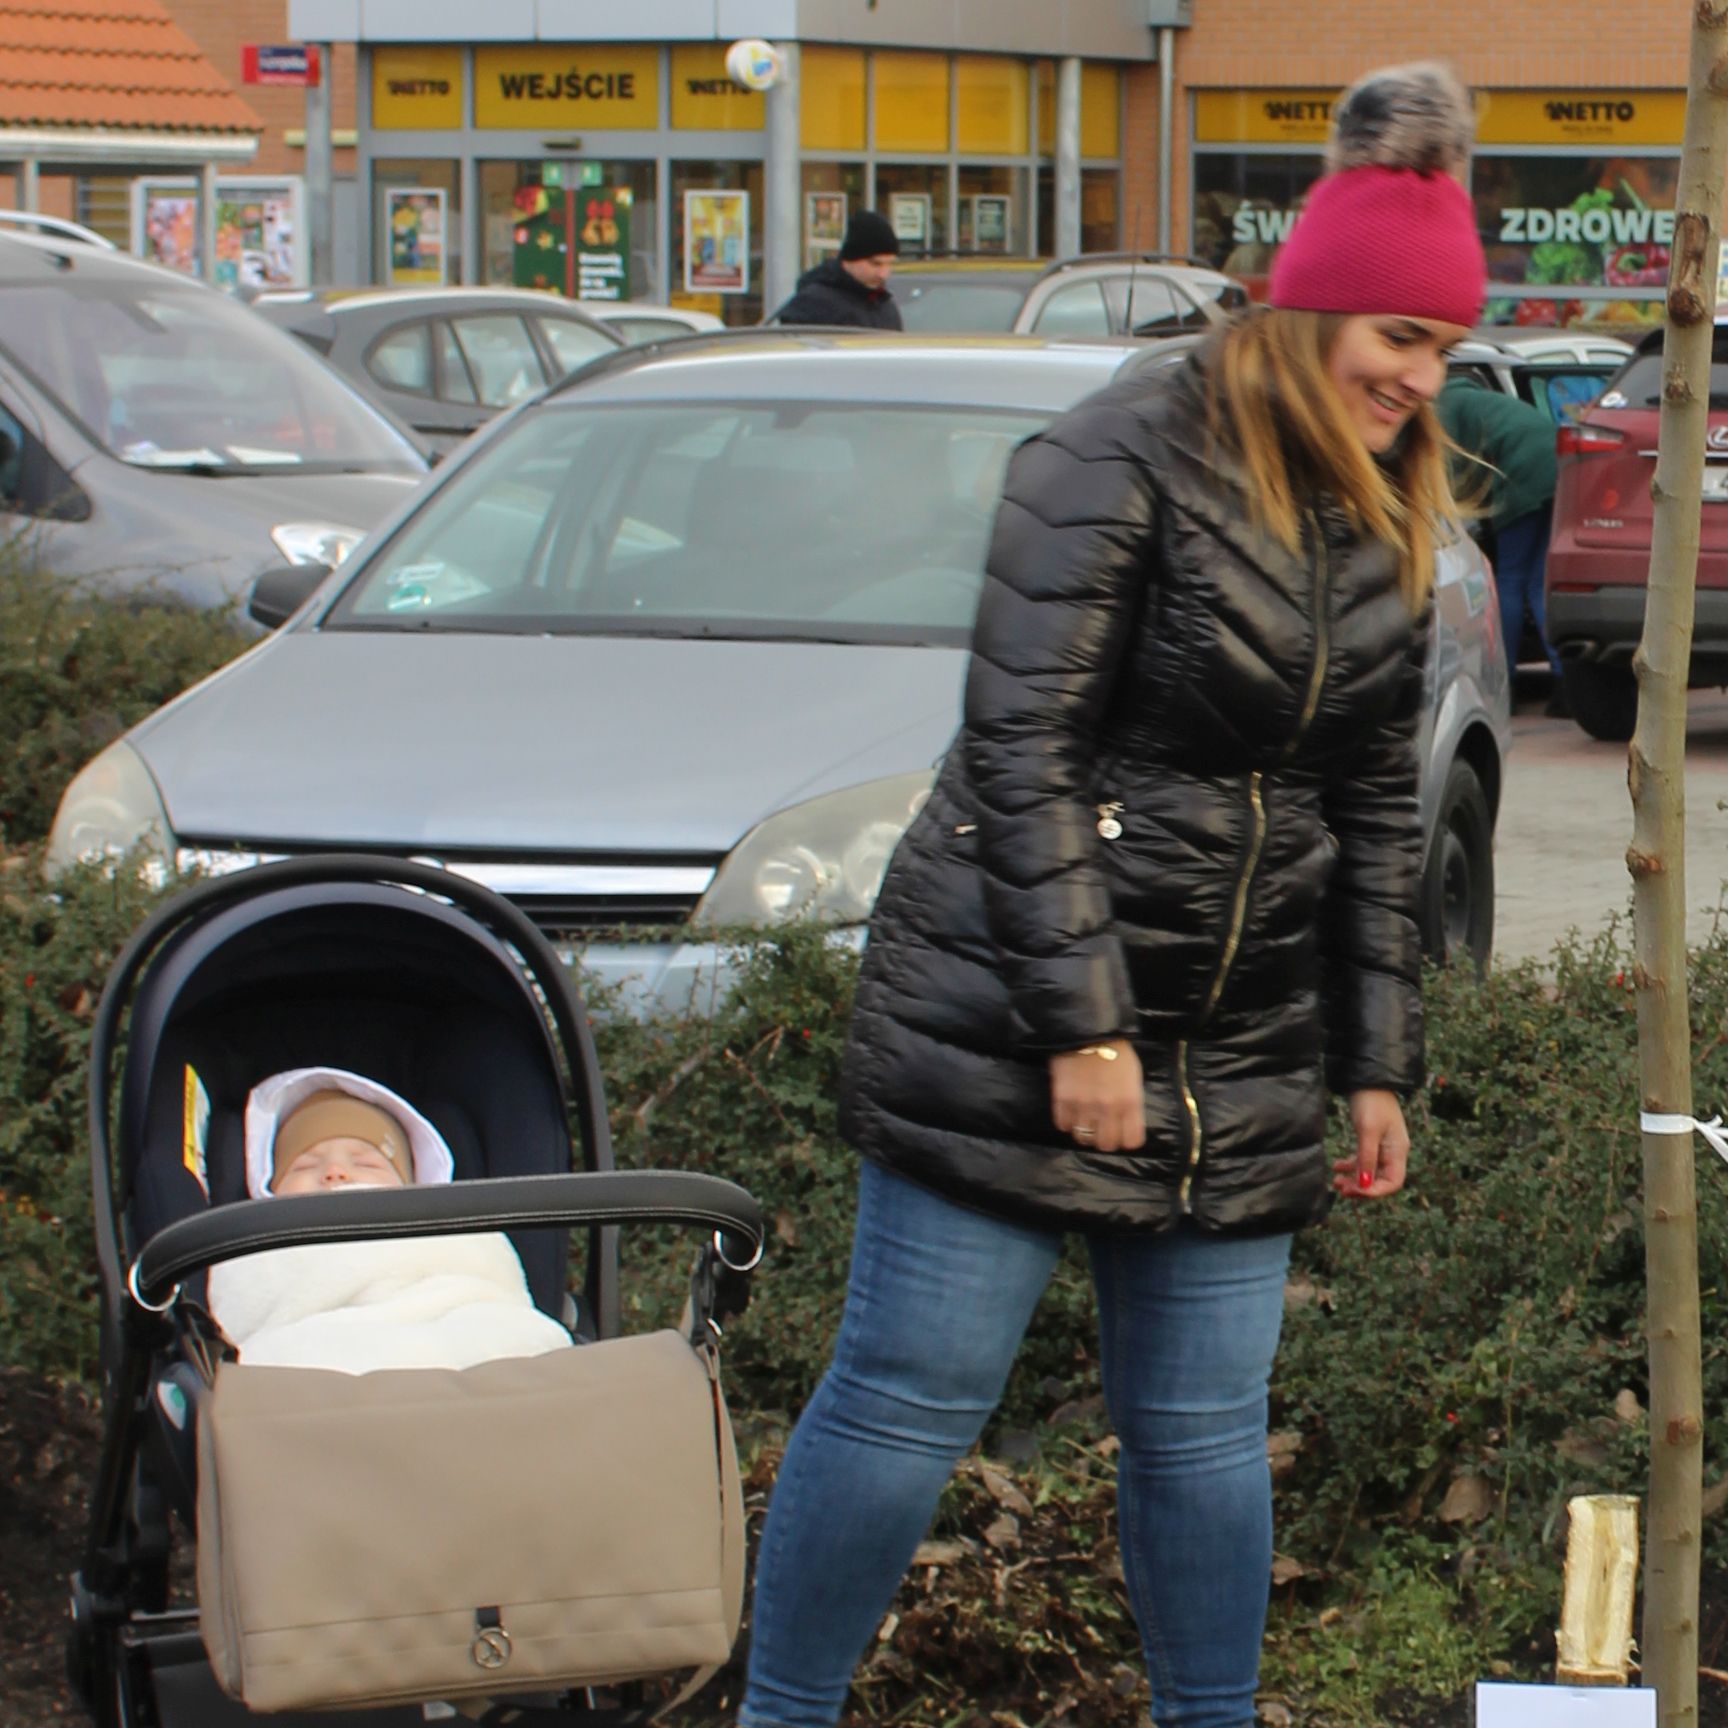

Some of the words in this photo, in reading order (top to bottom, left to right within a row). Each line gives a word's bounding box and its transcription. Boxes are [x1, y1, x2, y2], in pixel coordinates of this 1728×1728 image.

[499, 66, 636, 100] WEJŚCIE
[1264, 100, 1331, 121] NETT
[1545, 101, 1635, 122] NETTO
